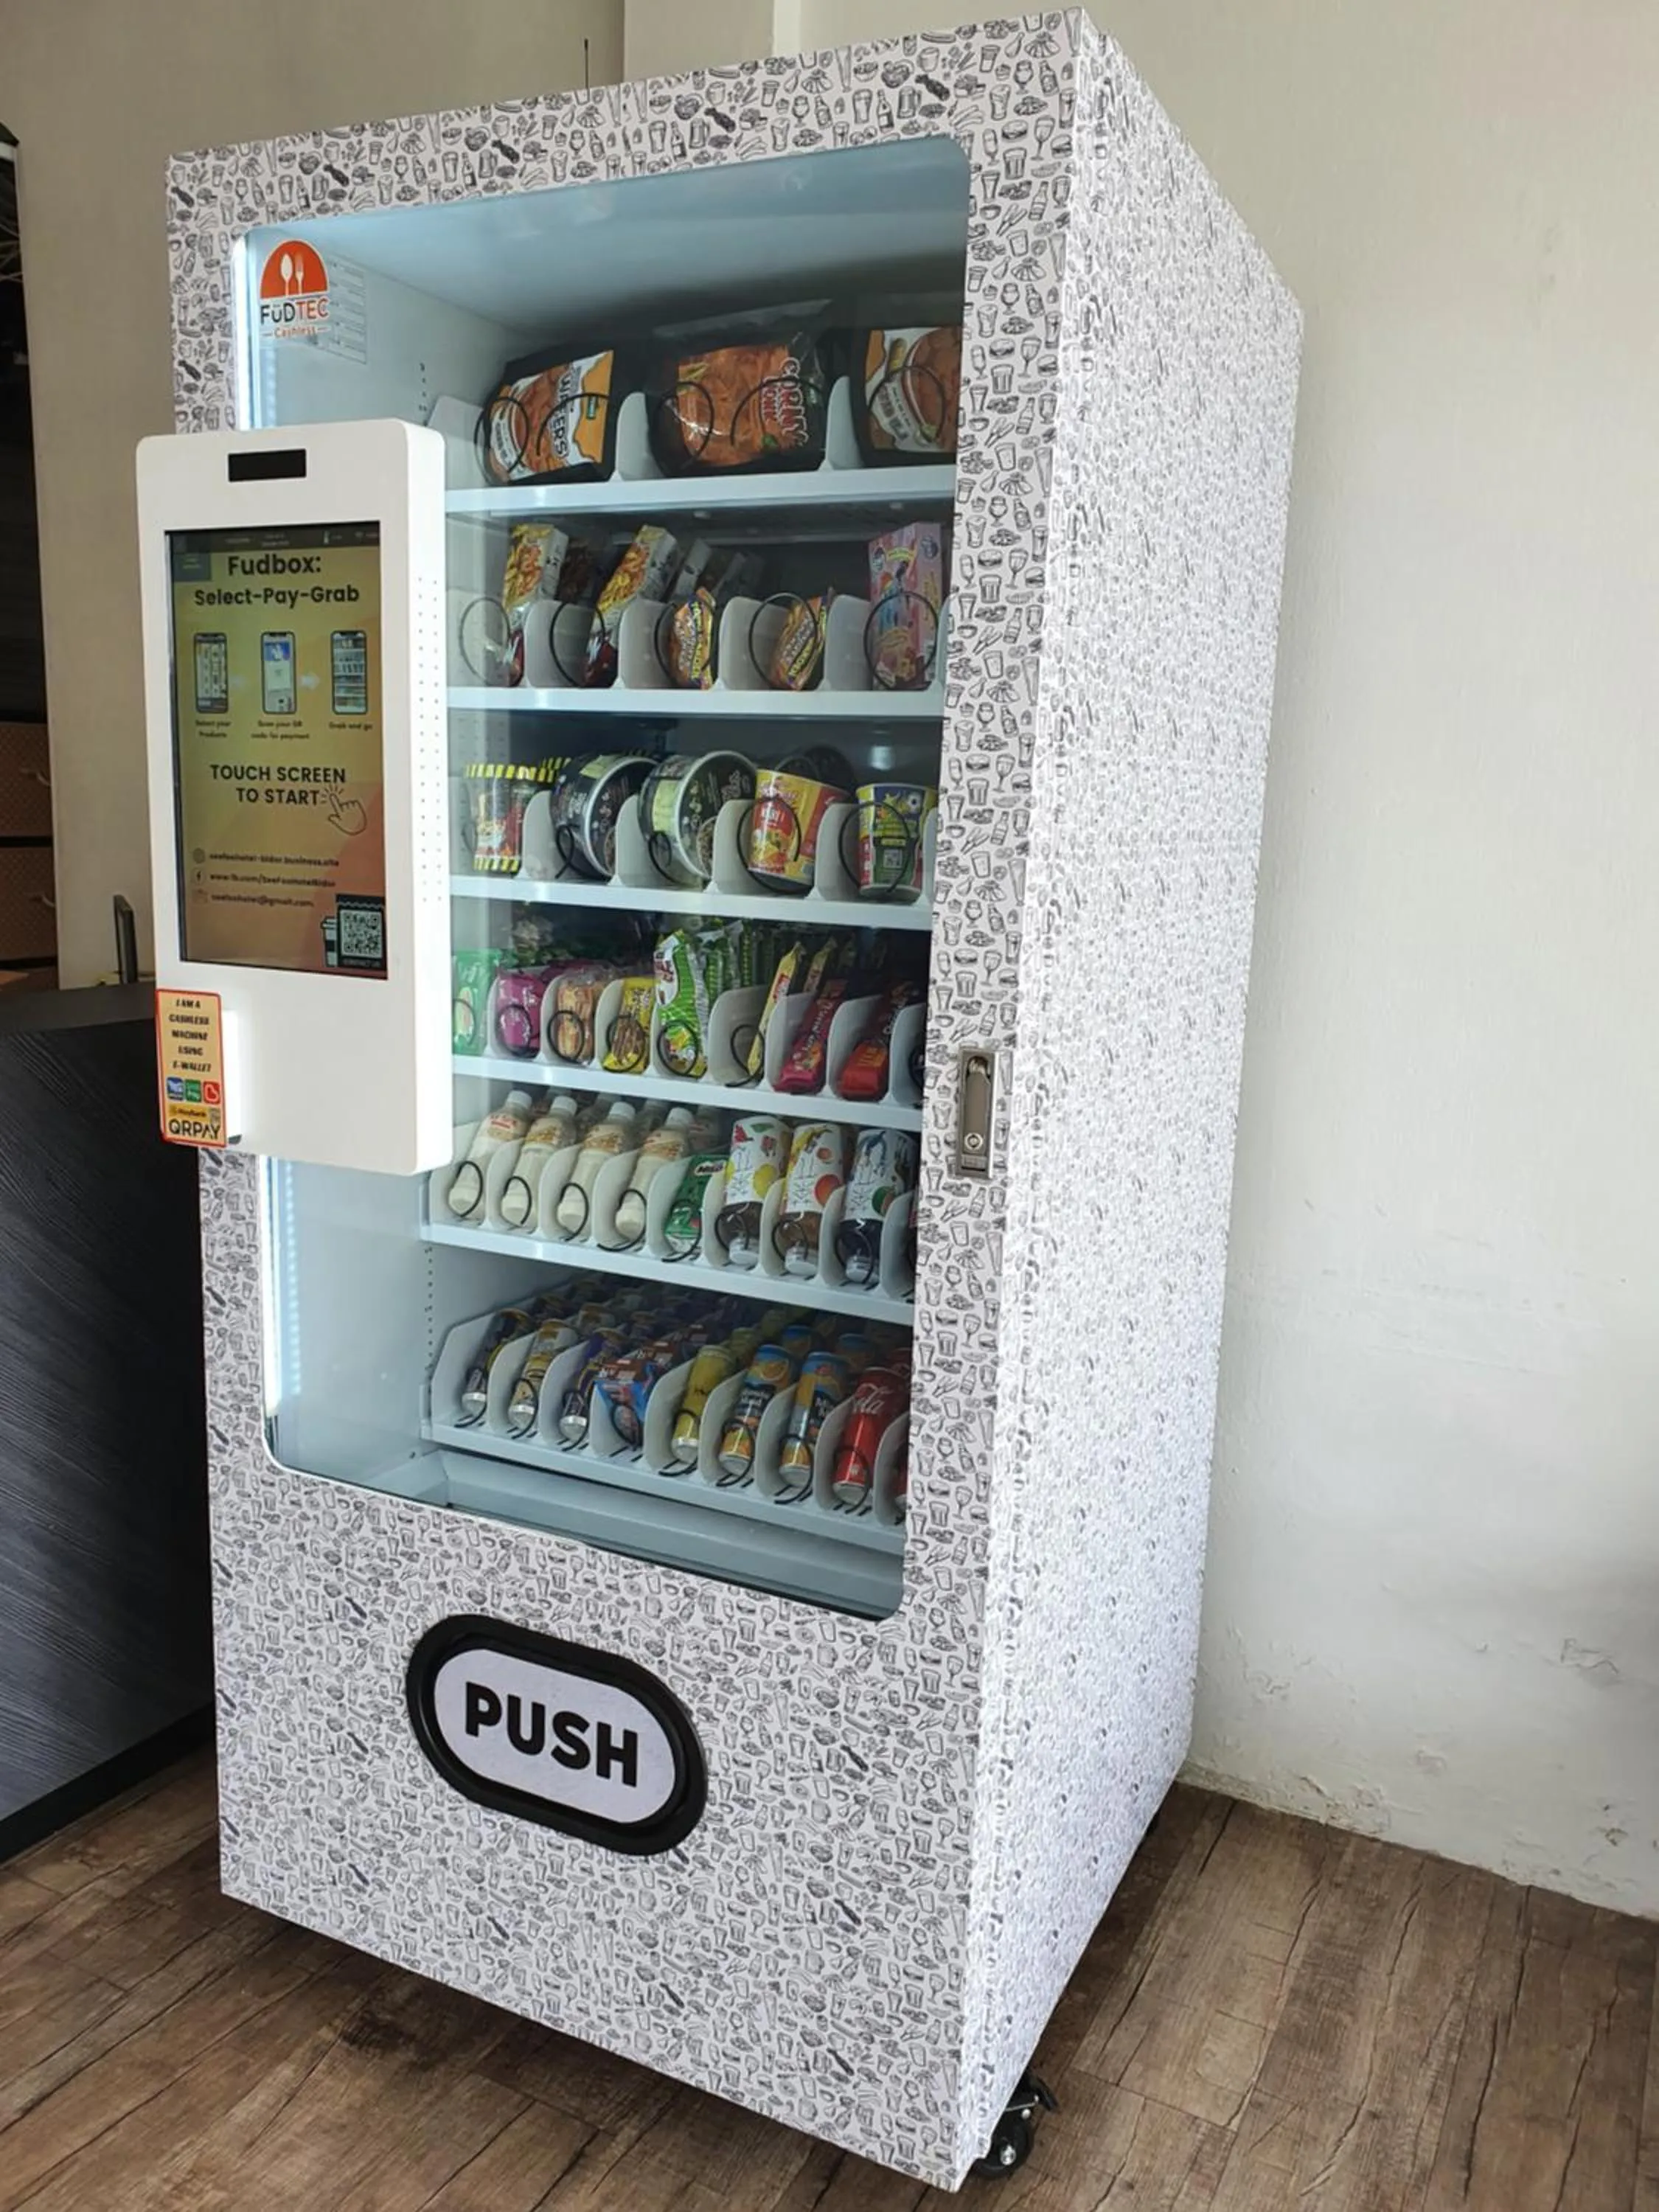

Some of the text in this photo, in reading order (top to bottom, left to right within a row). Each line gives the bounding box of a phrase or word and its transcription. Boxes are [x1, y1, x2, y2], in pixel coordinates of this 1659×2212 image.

[228, 554, 321, 576] Fudbox:
[194, 585, 360, 608] Select-Pay-Grab
[209, 764, 346, 784] TOUCH SCREEN
[236, 787, 320, 806] TO START
[181, 999, 194, 1009] AM
[169, 1013, 209, 1026] CASHLESS
[172, 1029, 208, 1040] MACHINE
[178, 1046, 204, 1056] USING
[173, 1061, 212, 1073] E-WALLET
[169, 1119, 220, 1140] QRPAY
[465, 1681, 638, 1788] PUSH
